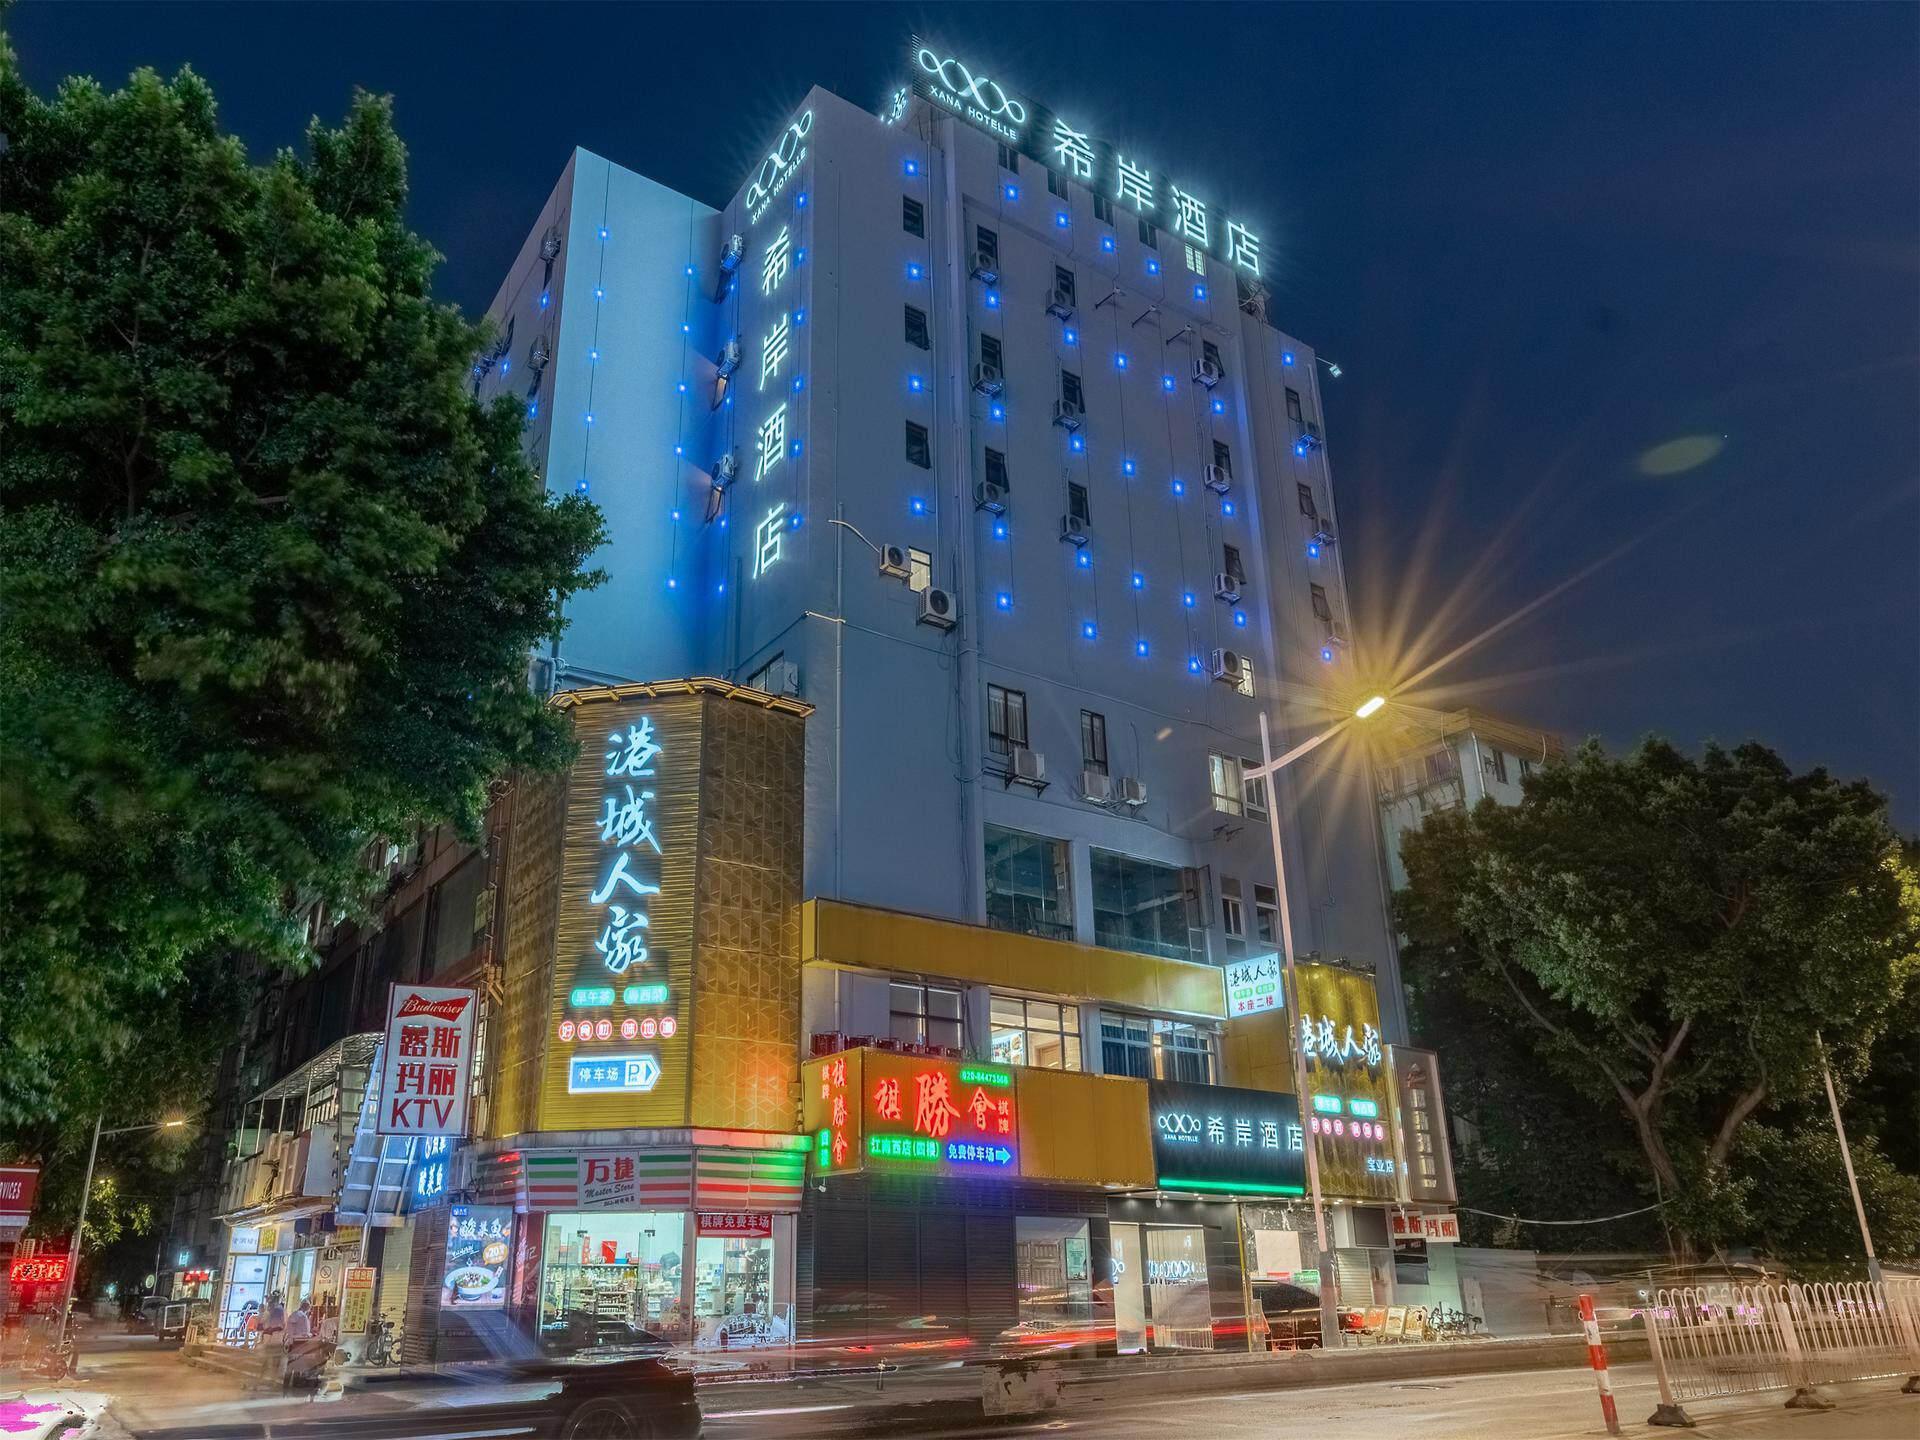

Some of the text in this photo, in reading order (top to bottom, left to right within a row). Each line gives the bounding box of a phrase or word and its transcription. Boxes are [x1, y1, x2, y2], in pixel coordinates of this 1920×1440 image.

[929, 85, 962, 110] XANA
[968, 106, 1017, 140] HOTELLE
[751, 147, 806, 225] XANA HOTELLE
[1053, 117, 1261, 277] 希岸酒店
[753, 225, 790, 580] 希岸酒店
[590, 716, 664, 974] 港城人家
[1229, 959, 1279, 987] 港城人家
[402, 1000, 465, 1015] Budweiser
[399, 1025, 462, 1058] 露斯
[395, 1062, 459, 1096] 玛丽
[579, 1067, 619, 1083] 停车场
[391, 1098, 455, 1129] KTV
[998, 1099, 1009, 1134] 棋牌
[1207, 1115, 1304, 1152] 希岸酒店
[948, 1143, 995, 1162] 免费停车场
[584, 1156, 635, 1186] 万捷
[584, 1183, 635, 1199] Master Store
[459, 1217, 504, 1241] 酸菜鱼
[700, 1214, 770, 1229] 棋牌免费车场
